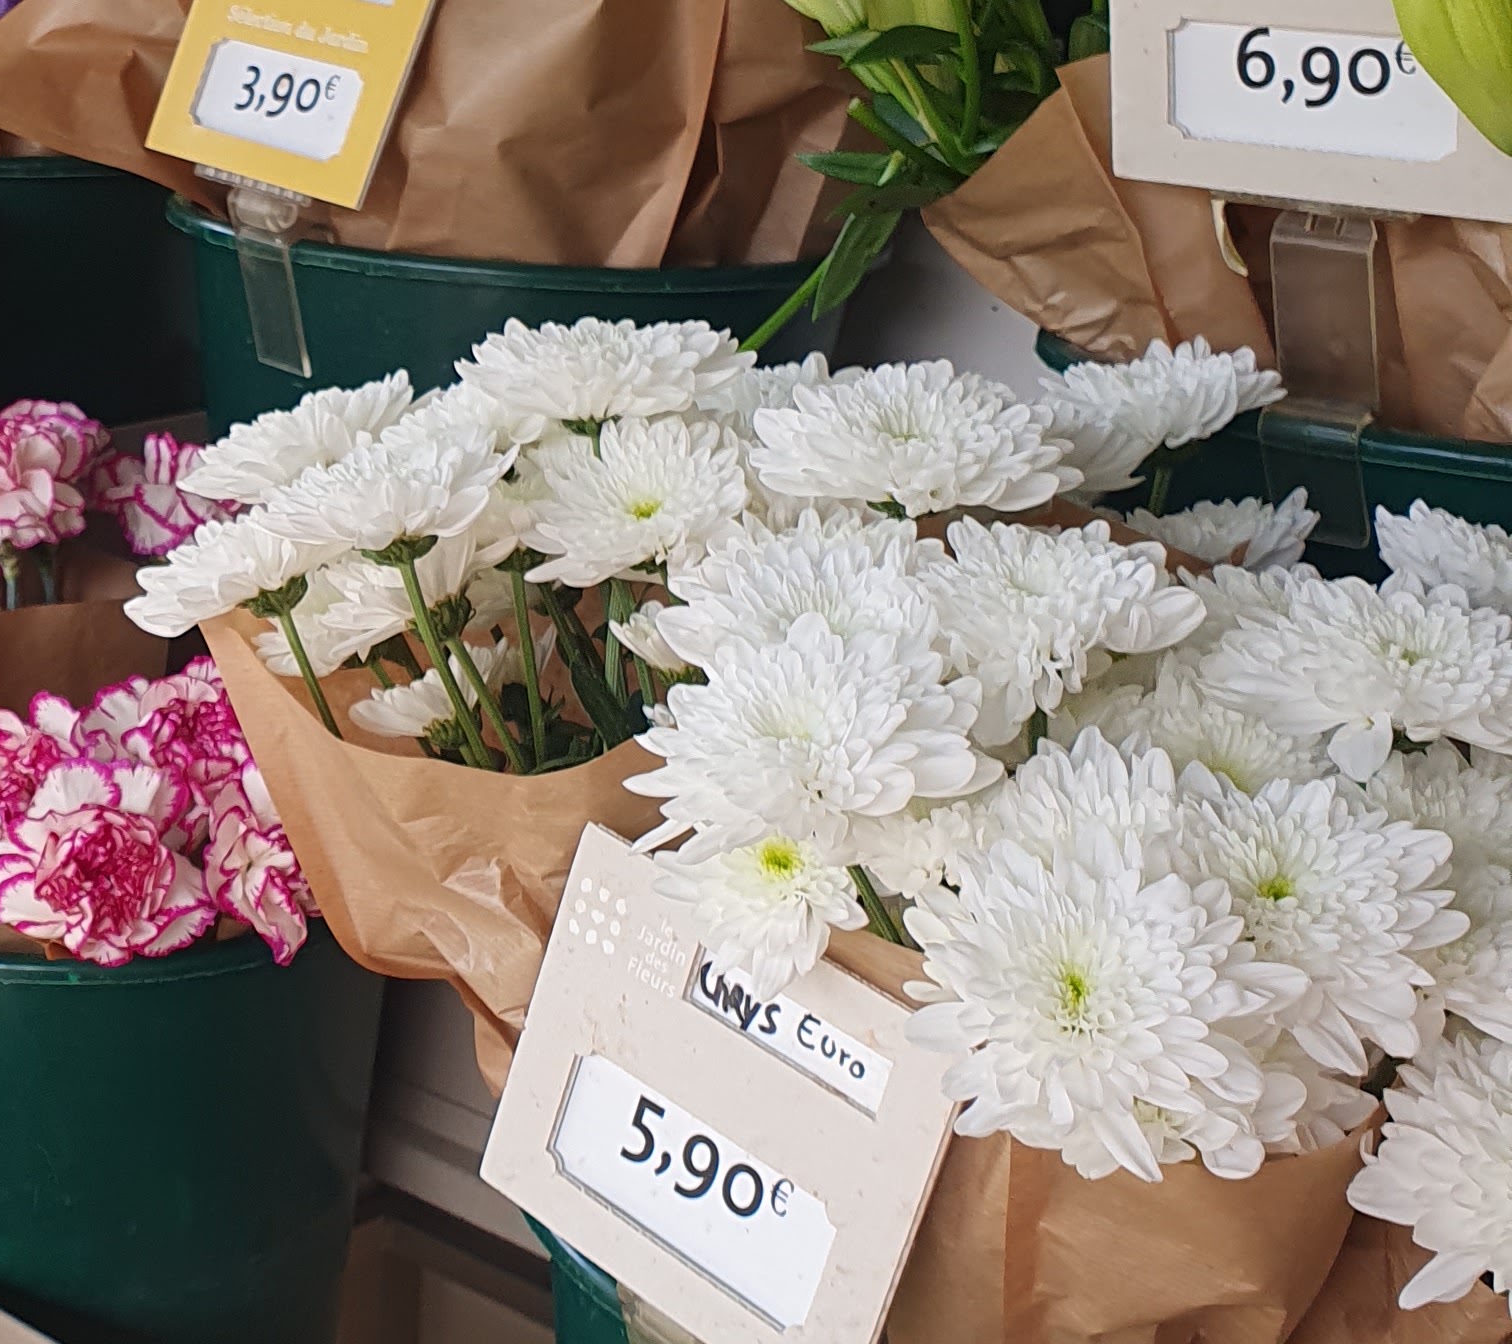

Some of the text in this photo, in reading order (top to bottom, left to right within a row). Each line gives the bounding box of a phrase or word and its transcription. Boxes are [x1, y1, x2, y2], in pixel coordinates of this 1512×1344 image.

[233, 65, 342, 119] 3,90€
[796, 1013, 866, 1079] Euro
[619, 1093, 795, 1219] 5,90€
